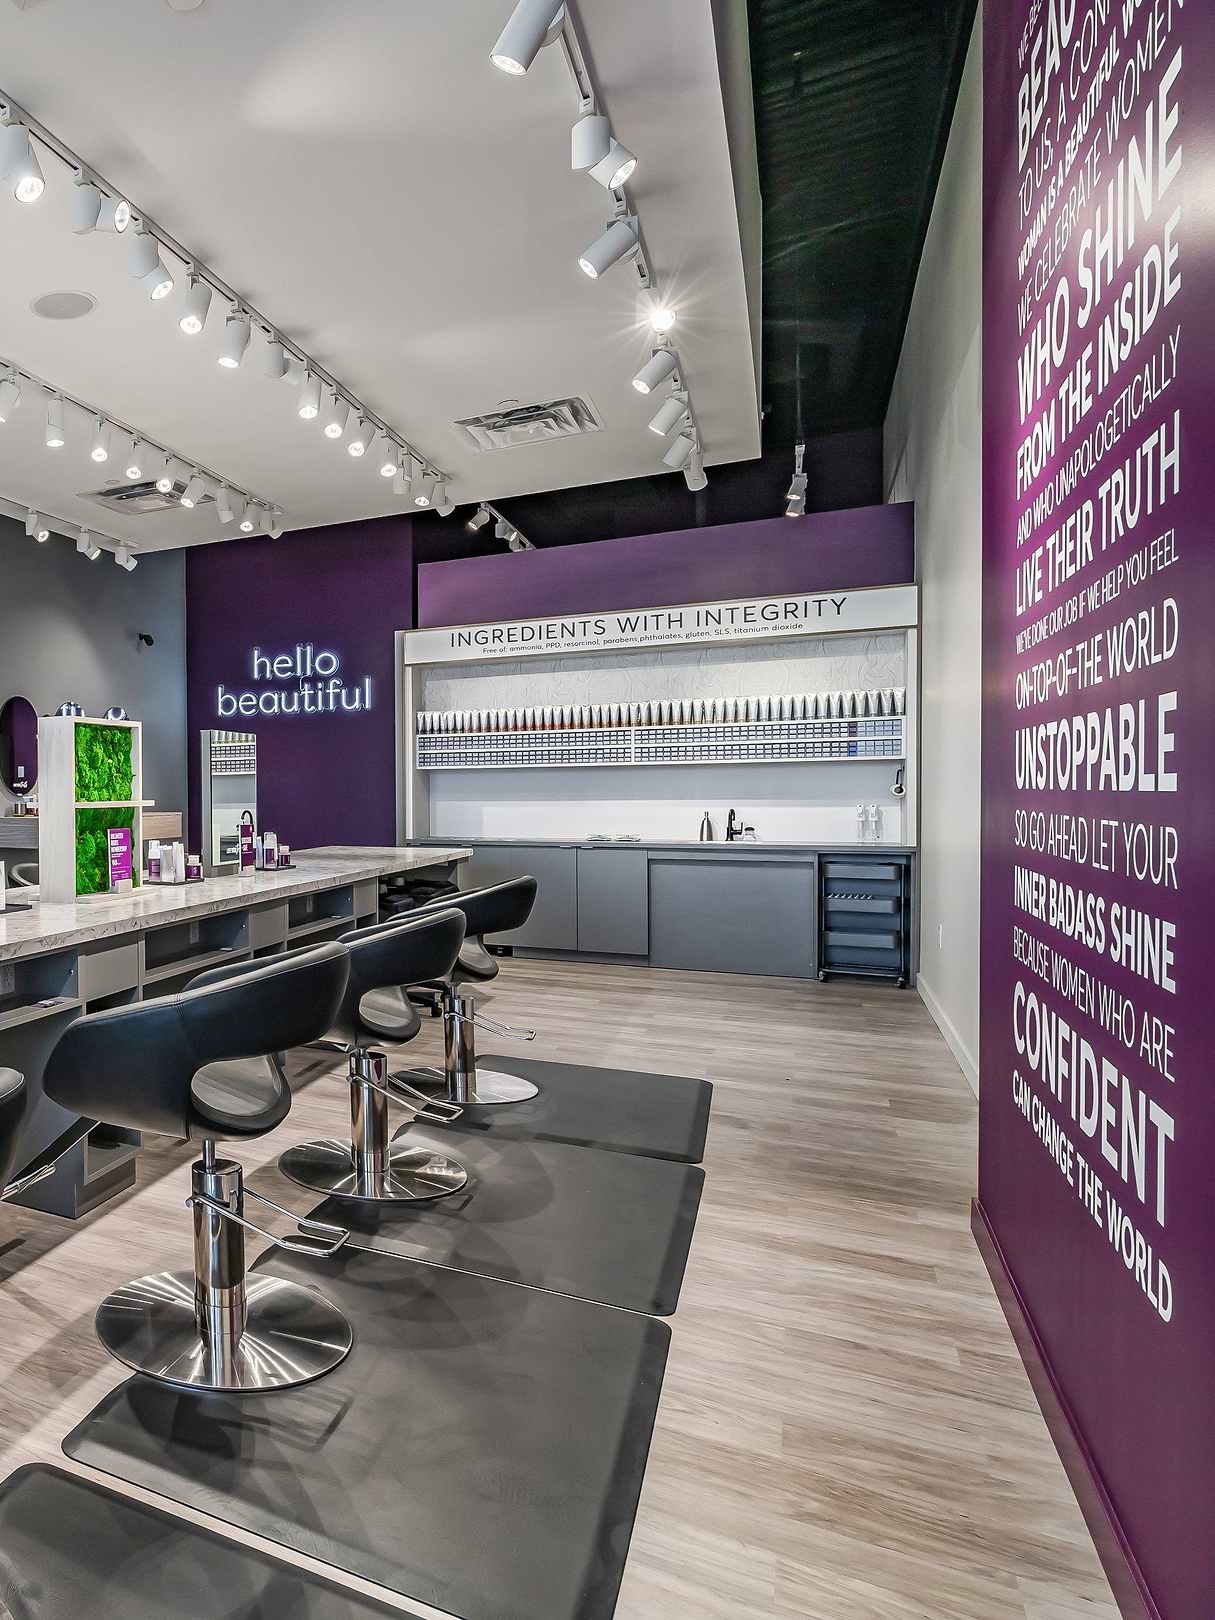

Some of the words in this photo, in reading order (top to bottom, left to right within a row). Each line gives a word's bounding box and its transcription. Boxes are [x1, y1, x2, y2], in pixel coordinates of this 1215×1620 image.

[1018, 22, 1029, 69] WE
[1018, 195, 1047, 281] WOMAN
[1048, 176, 1056, 216] IS
[1057, 160, 1064, 197] A
[1065, 26, 1120, 178] BEAUTIFUL
[1018, 168, 1033, 230] TO
[1035, 118, 1053, 188] US,
[1057, 83, 1067, 142] A
[1017, 276, 1070, 425] WHO
[1077, 46, 1182, 328] SHINE
[1018, 277, 1032, 336] WE
[1035, 127, 1101, 302] CELEBRATE
[1016, 398, 1055, 501] FROM
[1059, 341, 1093, 443] THE
[1097, 204, 1181, 395] INSIDE
[1016, 507, 1032, 549] AND
[1033, 481, 1054, 530] WHO
[1056, 324, 1181, 506] UNAPOLOGETICALLY
[1016, 545, 1043, 617] LIVE
[1046, 499, 1094, 593] THEIR
[1098, 408, 1180, 551] TRUTH
[451, 619, 606, 648] INGREDIENTS
[616, 611, 683, 634] WITH
[696, 597, 848, 627] INTEGRITY
[509, 643, 544, 652] ammonia,
[545, 641, 562, 649] PPD,
[563, 638, 601, 648] resorcinol,
[685, 630, 712, 640] gluten,
[734, 625, 770, 634] titanium
[771, 622, 804, 631] dioxide
[1031, 615, 1049, 647] DONE
[1049, 605, 1063, 636] OUR
[1063, 596, 1078, 628] JOB
[1079, 589, 1087, 619] IF
[1087, 580, 1101, 613] WE
[1101, 564, 1124, 605] HELP
[1125, 546, 1148, 589] YOU
[1150, 528, 1180, 575] FEEL
[1107, 597, 1179, 679] WORLD
[217, 675, 372, 717] beautiful
[253, 643, 340, 680] hello
[1015, 691, 1178, 792] UNSTOPPABLE
[1014, 809, 1028, 847] SO
[1029, 811, 1046, 853] GO
[1047, 813, 1088, 864] AHEAD
[1092, 818, 1119, 872] LET
[1123, 821, 1178, 890] YOUR
[1014, 865, 1046, 923] INNER
[1049, 877, 1106, 955] BADASS
[1110, 902, 1176, 995] SHINE
[1013, 925, 1049, 983] BECAUSE
[1051, 949, 1095, 1020] WOMEN
[1098, 980, 1135, 1049] WHO
[1139, 1011, 1175, 1083] ARE
[1013, 980, 1175, 1228] CONFIDENT
[1012, 1069, 1031, 1122] CAN
[1032, 1094, 1074, 1187] CHANGE
[1076, 1152, 1103, 1229] THE
[1106, 1189, 1173, 1323] WORLD
